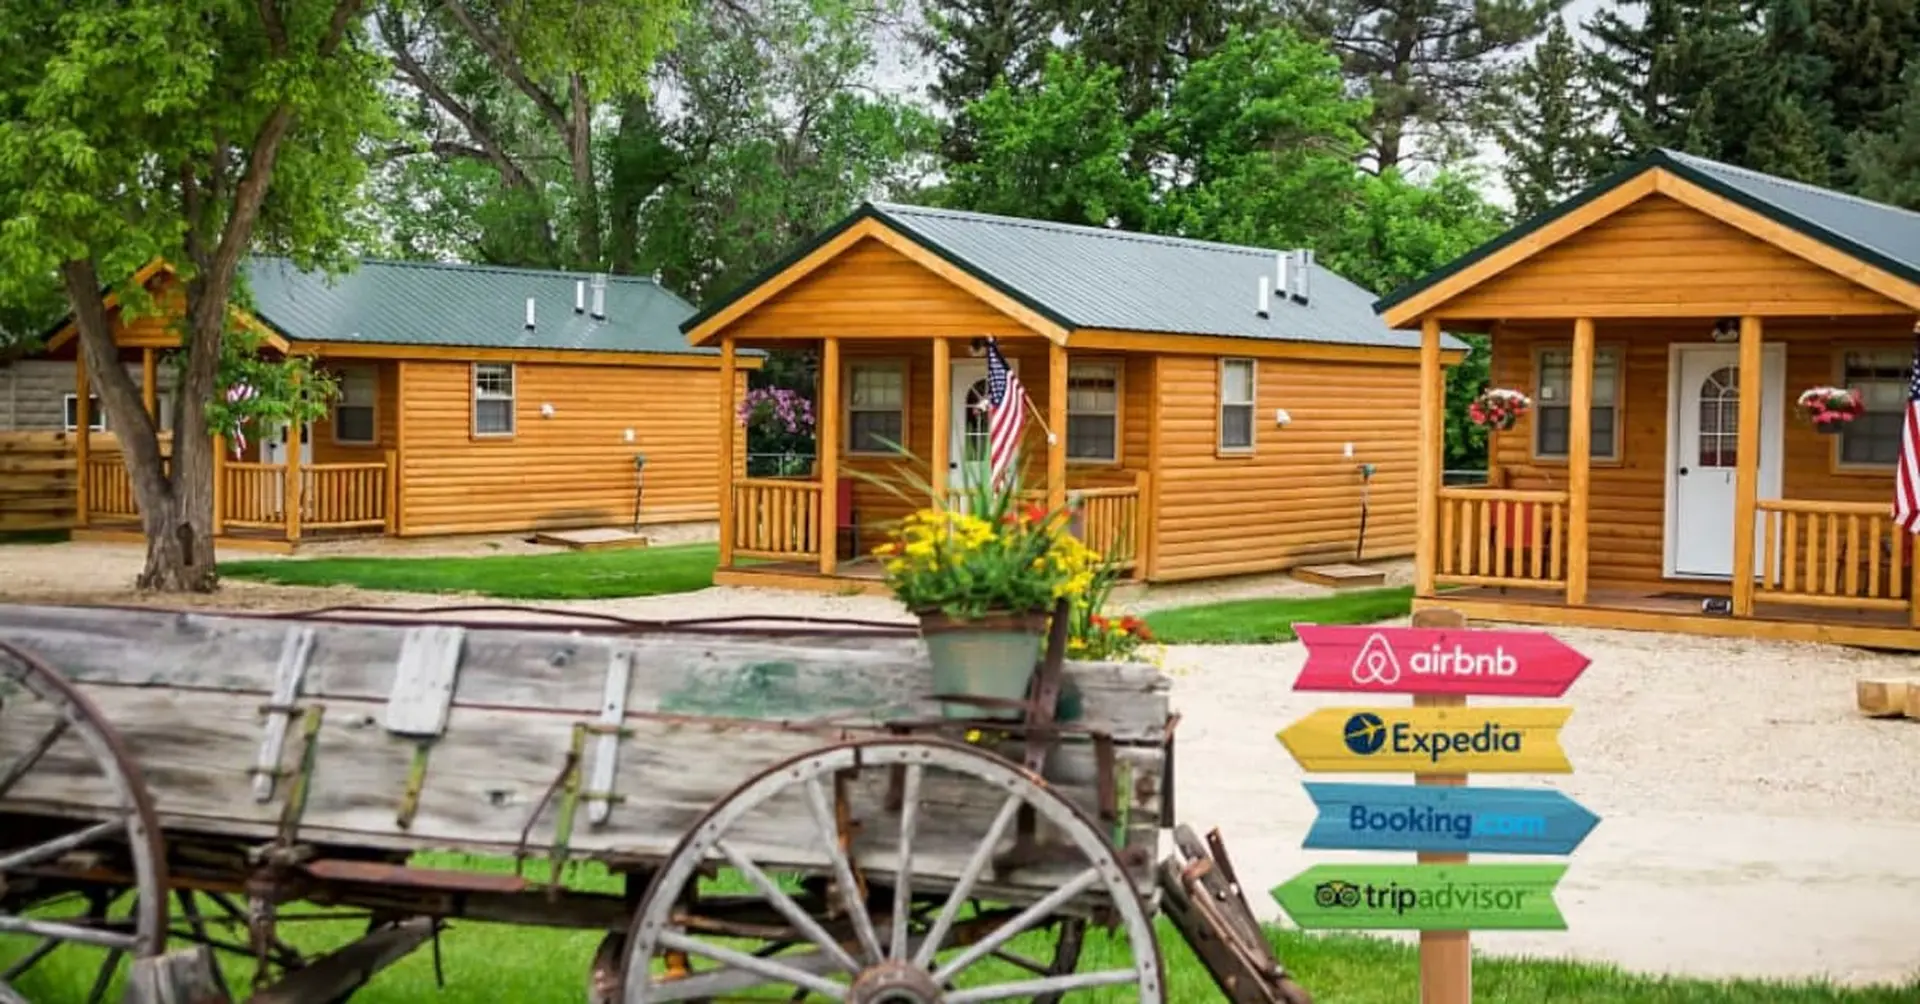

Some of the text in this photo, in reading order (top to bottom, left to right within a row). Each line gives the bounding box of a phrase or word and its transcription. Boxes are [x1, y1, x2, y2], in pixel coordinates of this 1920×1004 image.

[1410, 645, 1517, 676] airbnb
[1393, 723, 1521, 762] Expedia
[1350, 805, 1544, 838] Booking.com
[1366, 882, 1525, 914] tripadvisor
